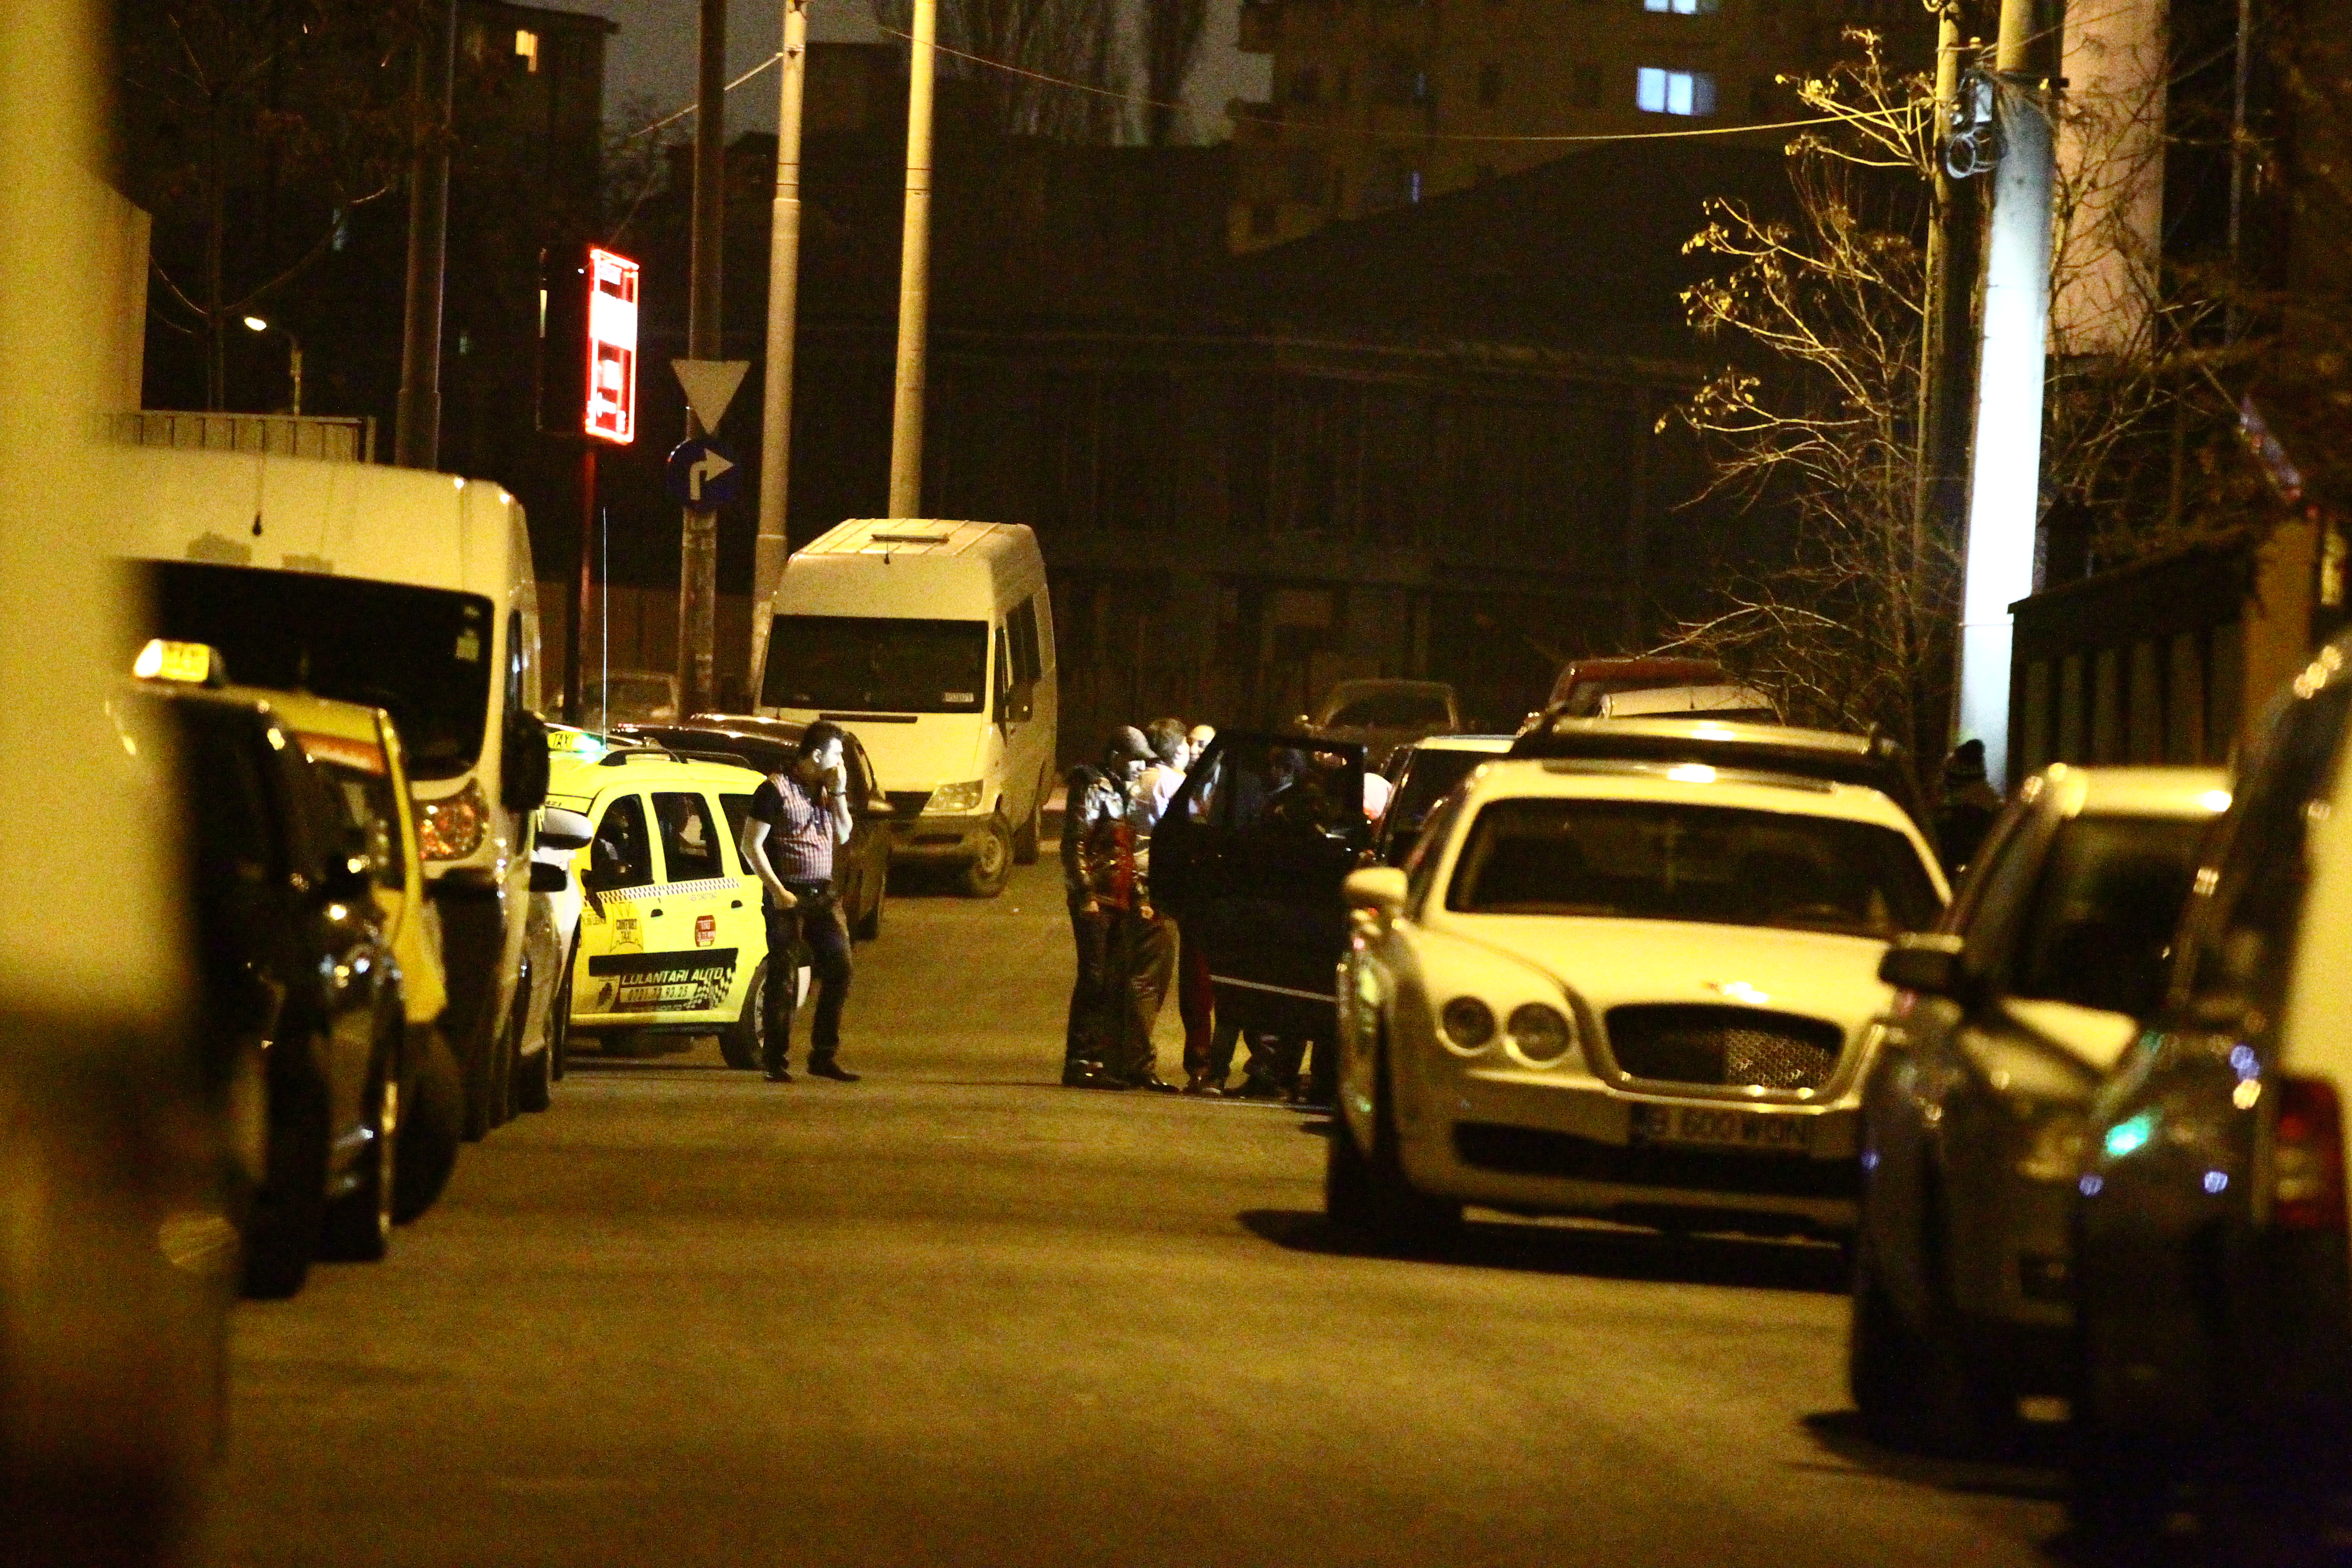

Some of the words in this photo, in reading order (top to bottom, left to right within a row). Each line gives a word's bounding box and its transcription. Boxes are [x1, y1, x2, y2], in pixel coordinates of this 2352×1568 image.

[553, 733, 574, 748] TAXI
[622, 969, 689, 985] COLANTARI
[691, 967, 724, 981] AUTO
